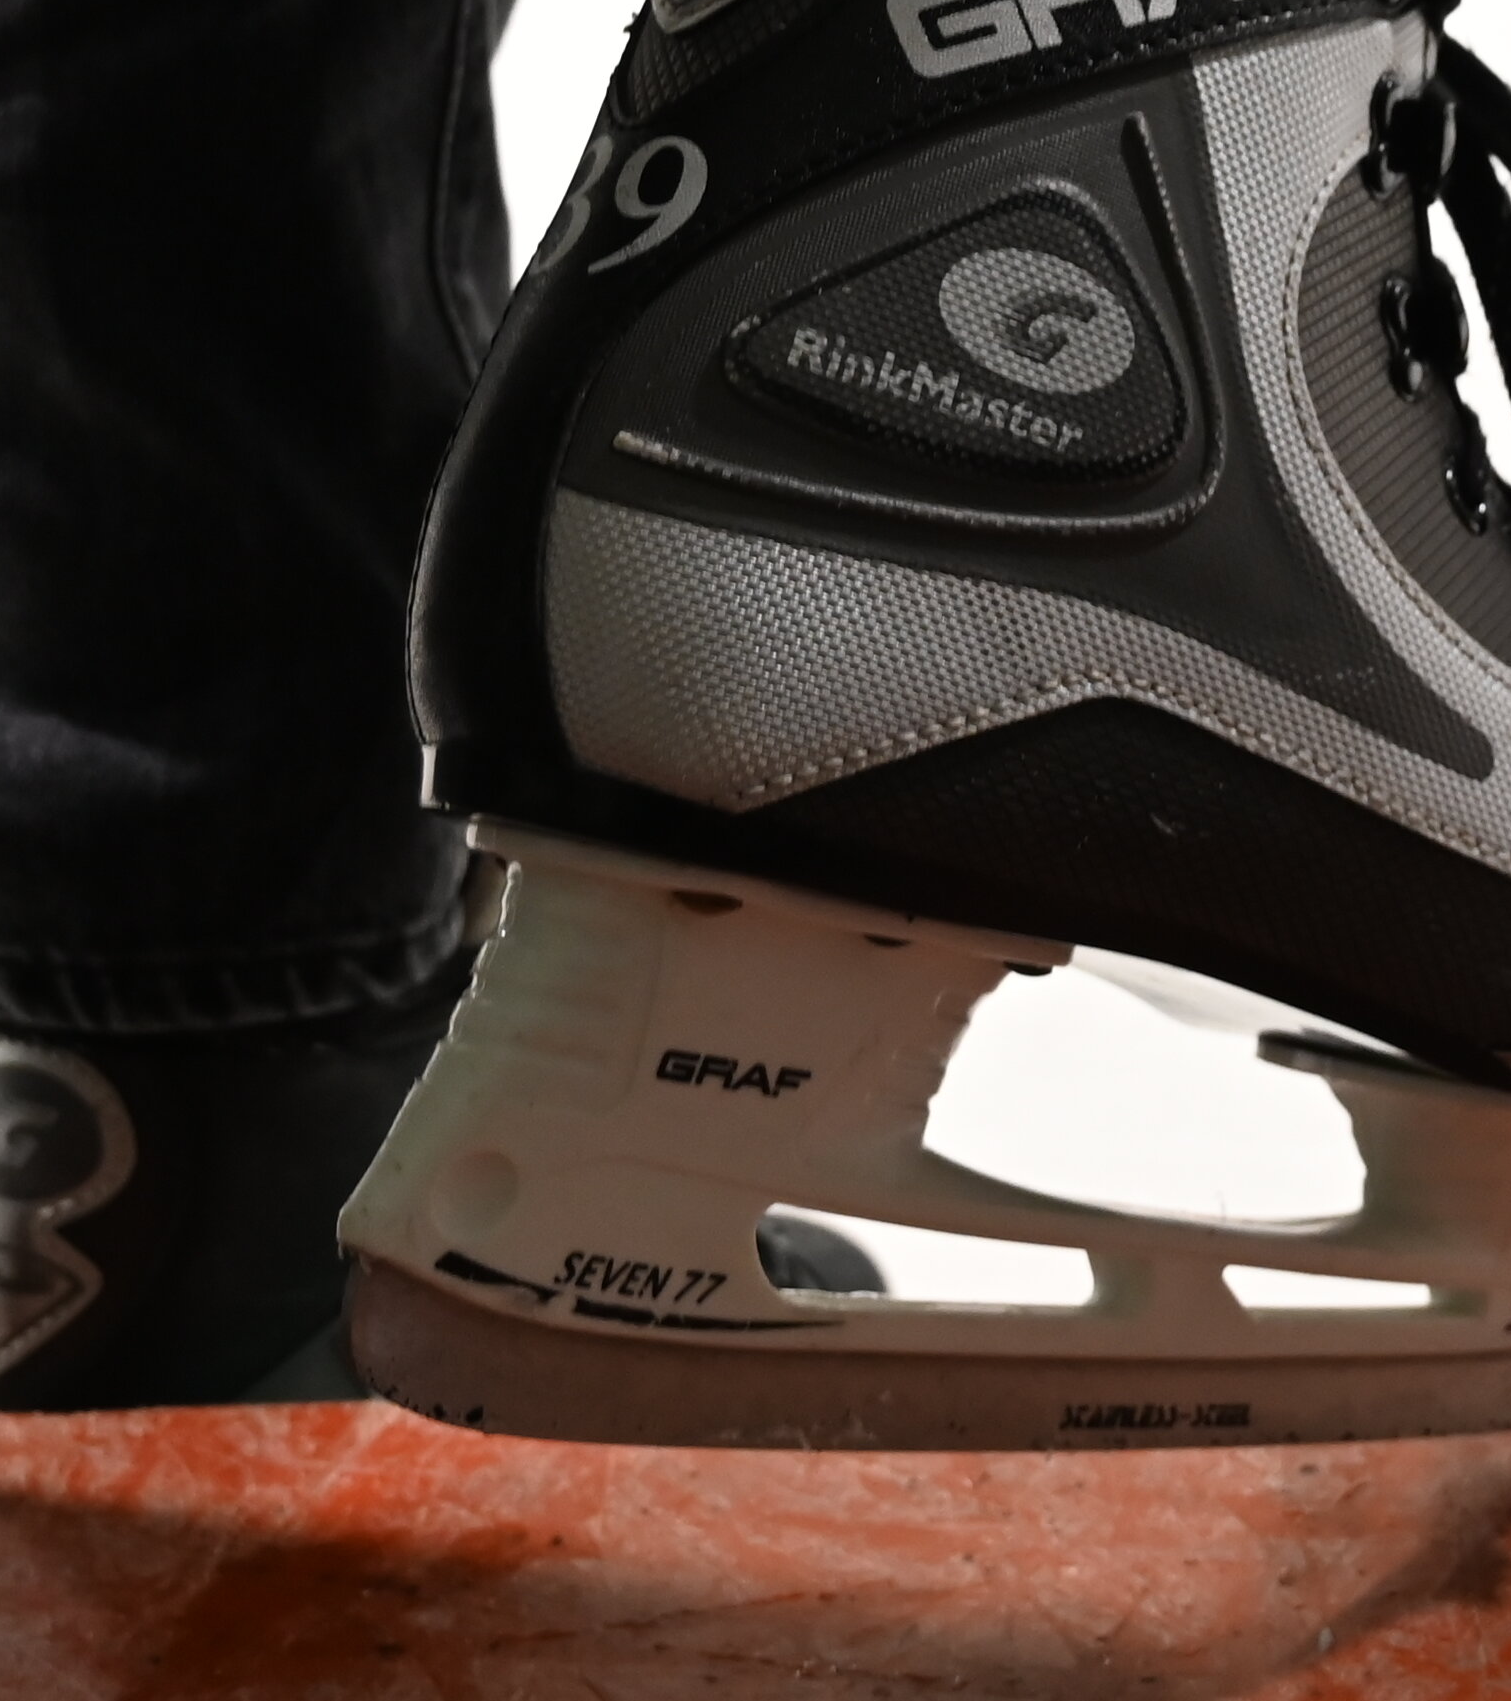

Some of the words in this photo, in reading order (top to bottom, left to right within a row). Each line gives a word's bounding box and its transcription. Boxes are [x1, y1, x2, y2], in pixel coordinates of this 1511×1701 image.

[787, 326, 1083, 451] RinkMaster
[656, 1049, 812, 1098] GRAF
[554, 1251, 673, 1299] SEVEN
[673, 1268, 728, 1306] 77
